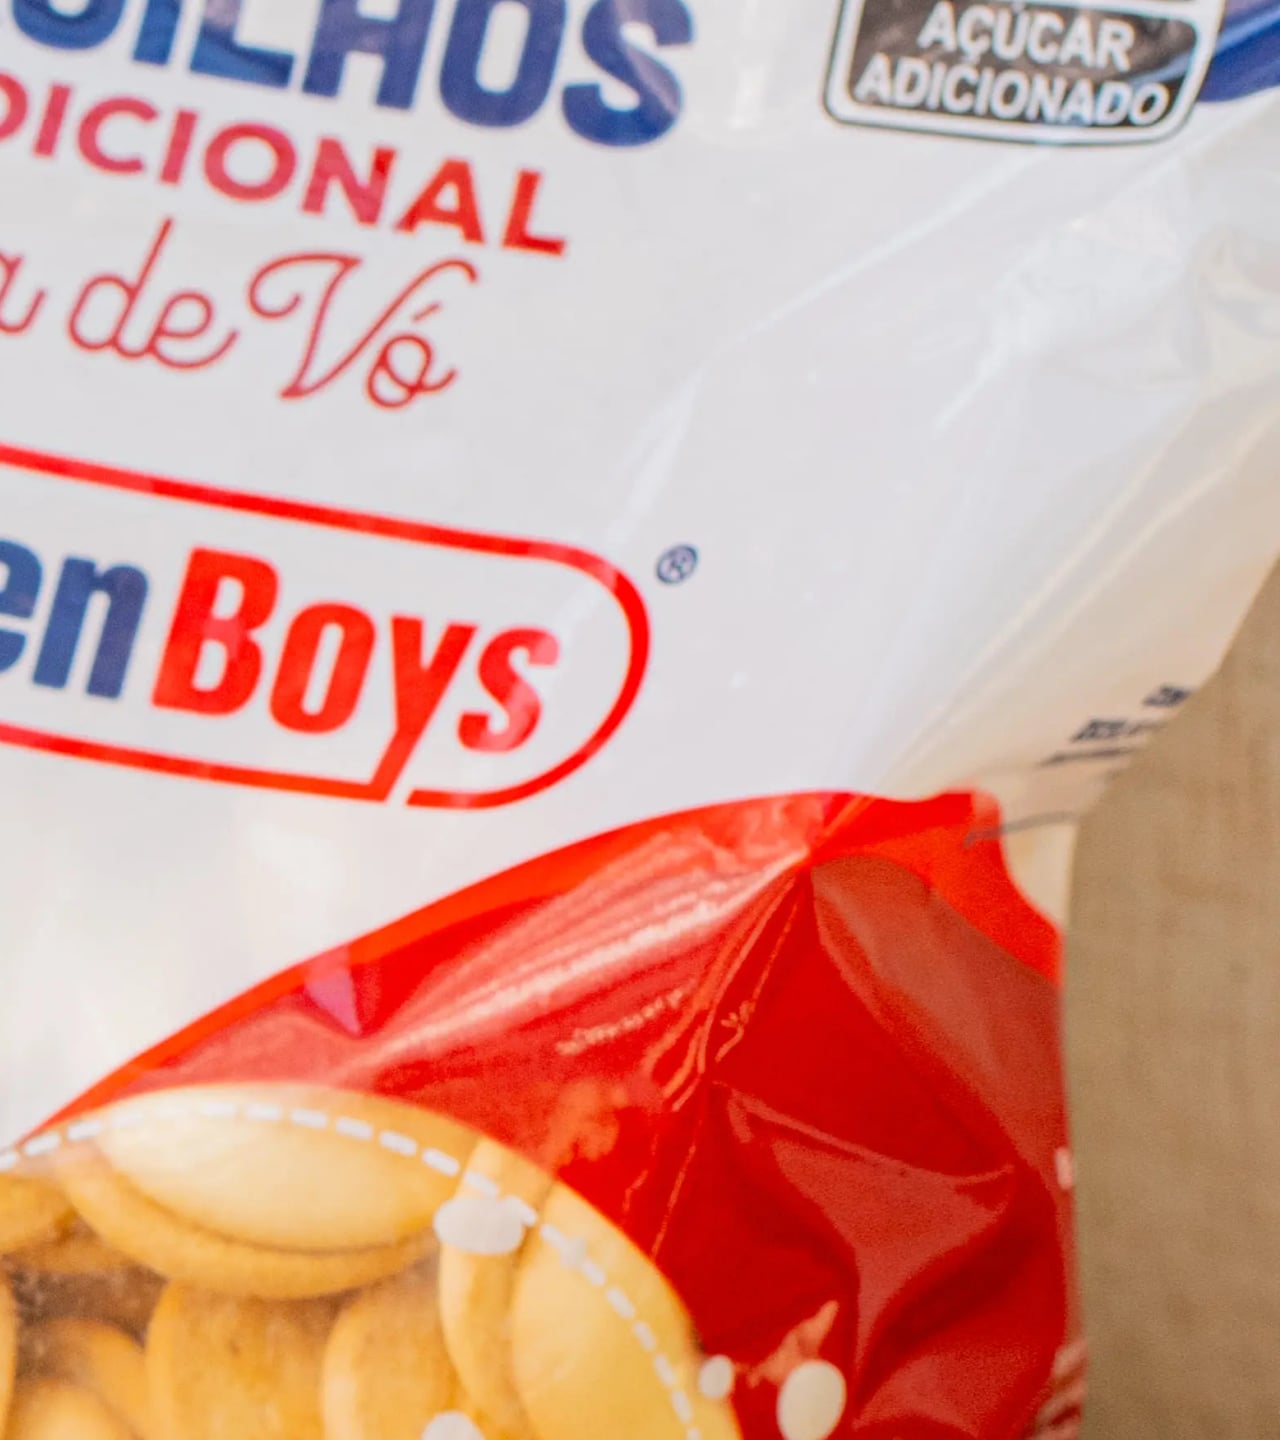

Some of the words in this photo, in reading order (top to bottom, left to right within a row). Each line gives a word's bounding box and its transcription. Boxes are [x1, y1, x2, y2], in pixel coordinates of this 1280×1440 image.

[917, 0, 1136, 72] AÇÚCAR
[853, 53, 1171, 127] ADICIONADO
[69, 217, 237, 369] de
[247, 252, 480, 409] Vó
